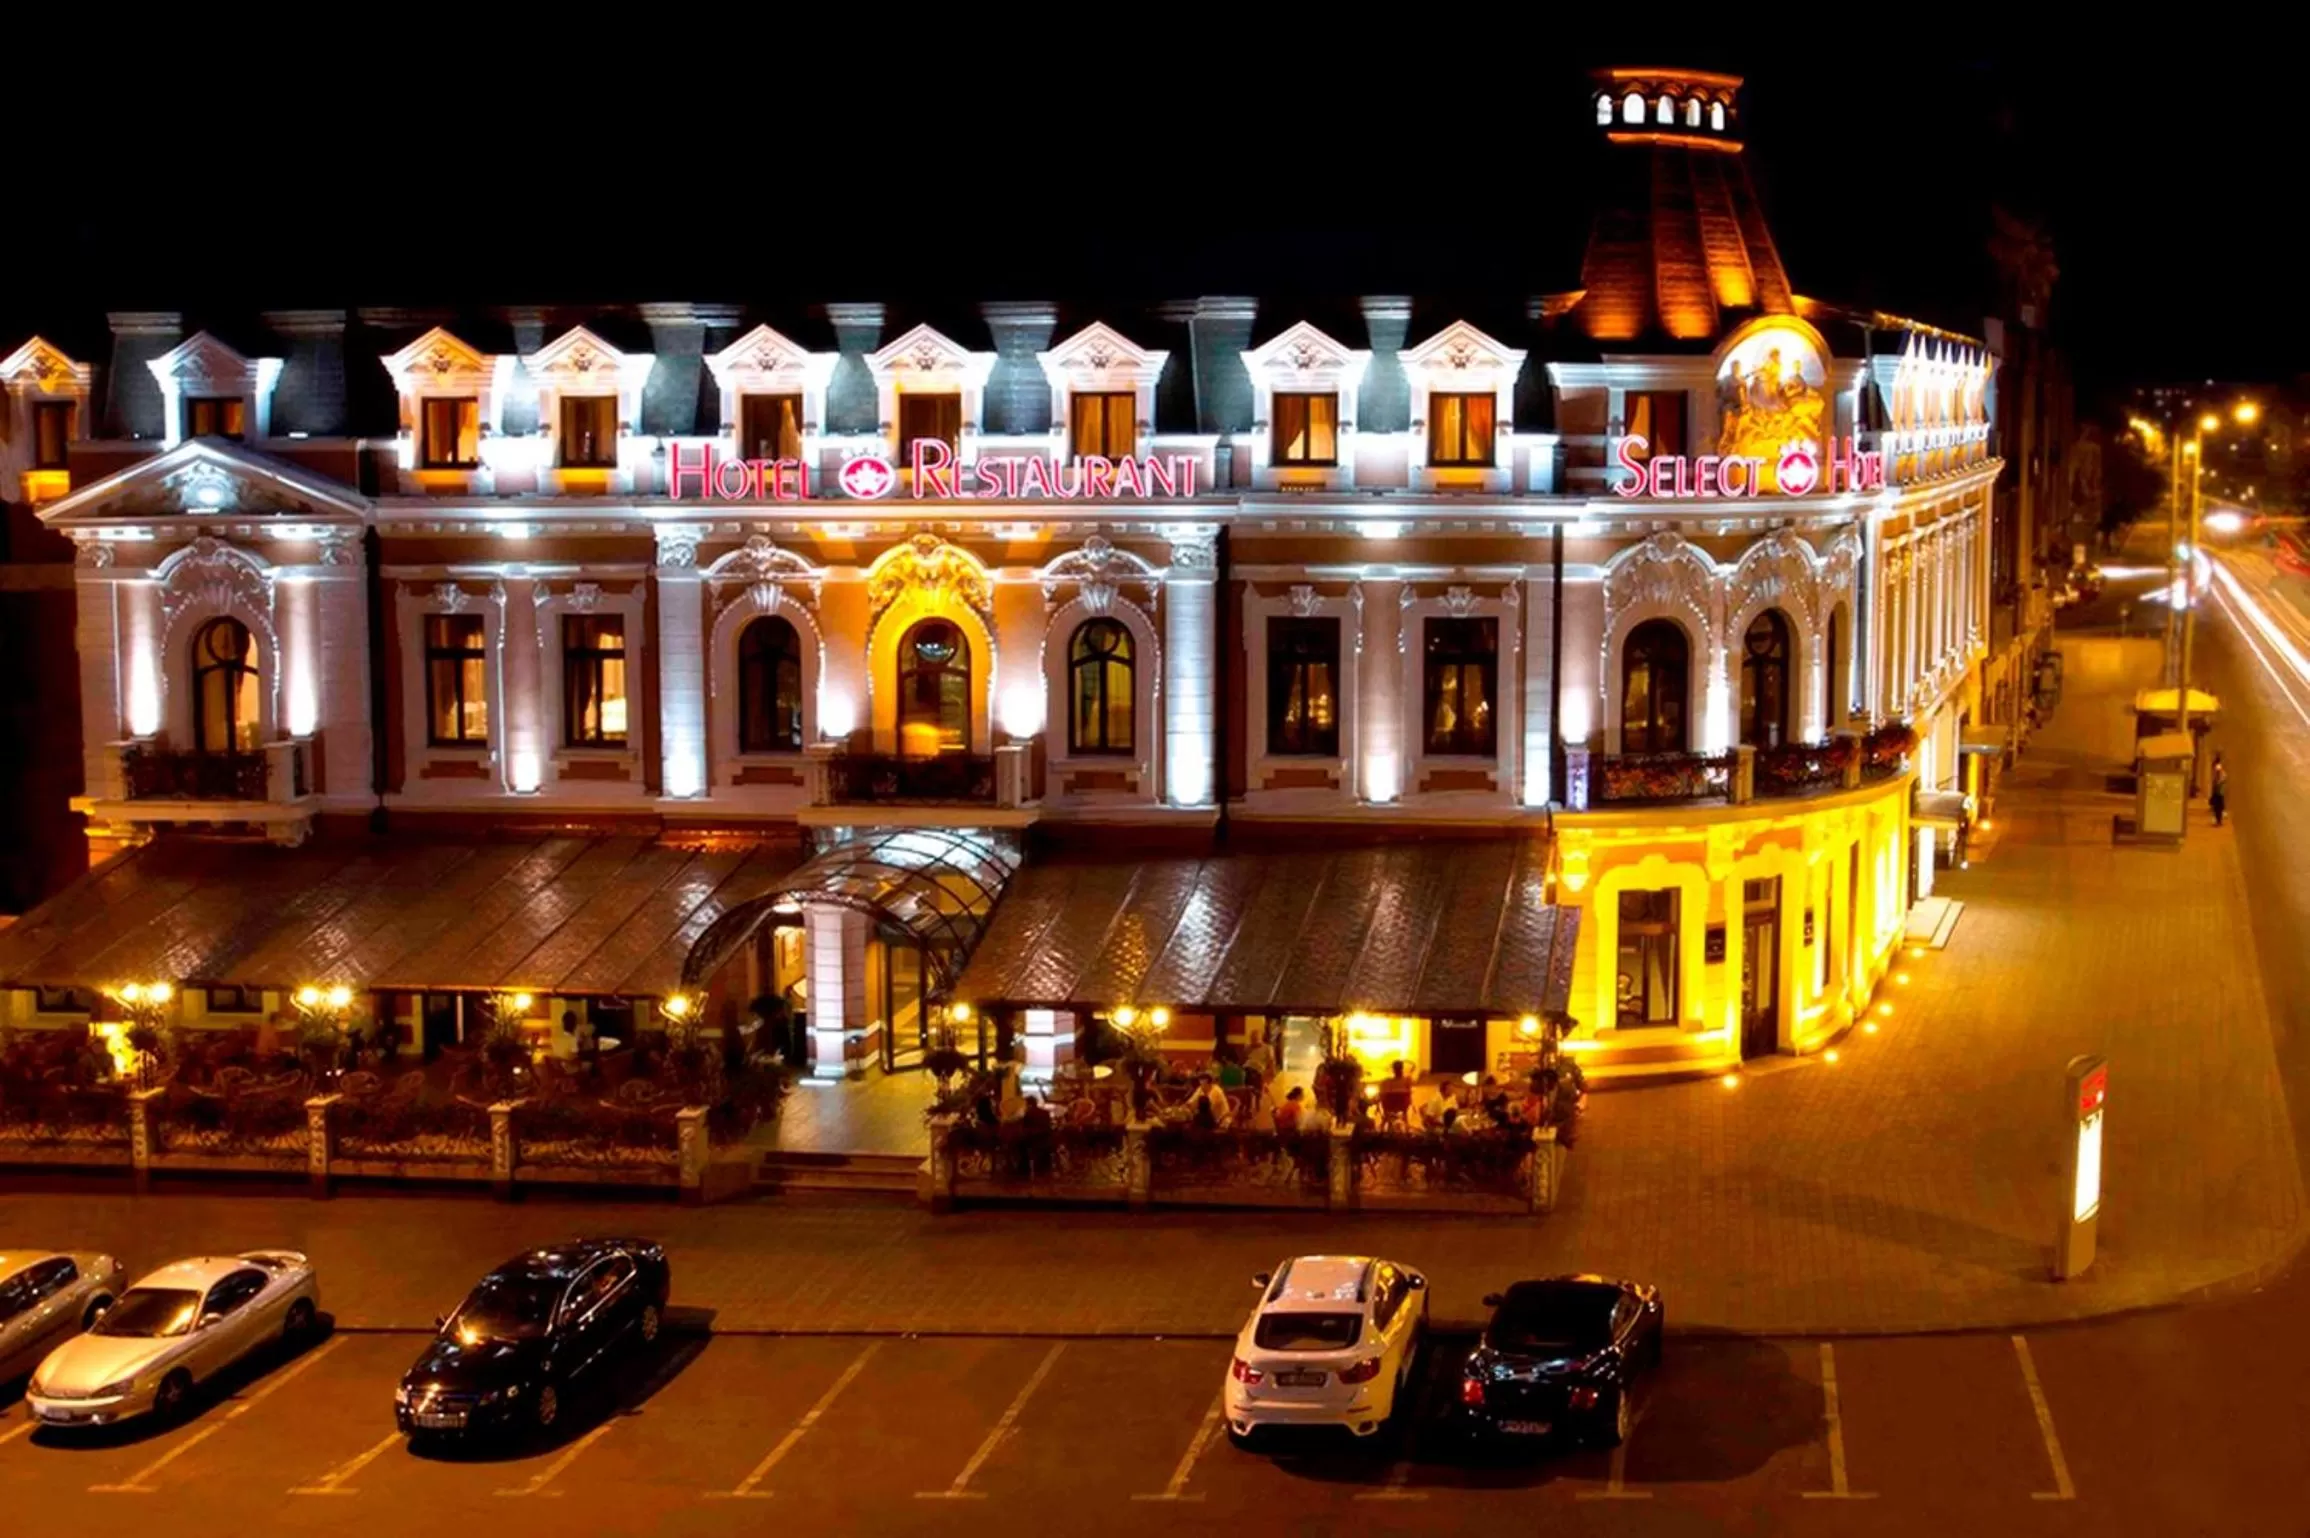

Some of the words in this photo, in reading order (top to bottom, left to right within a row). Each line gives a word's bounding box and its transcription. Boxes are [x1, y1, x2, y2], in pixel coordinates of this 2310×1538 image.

[670, 441, 814, 500] HOTEL
[911, 438, 1203, 499] RESTAURANT
[1615, 434, 1765, 498] SELECT
